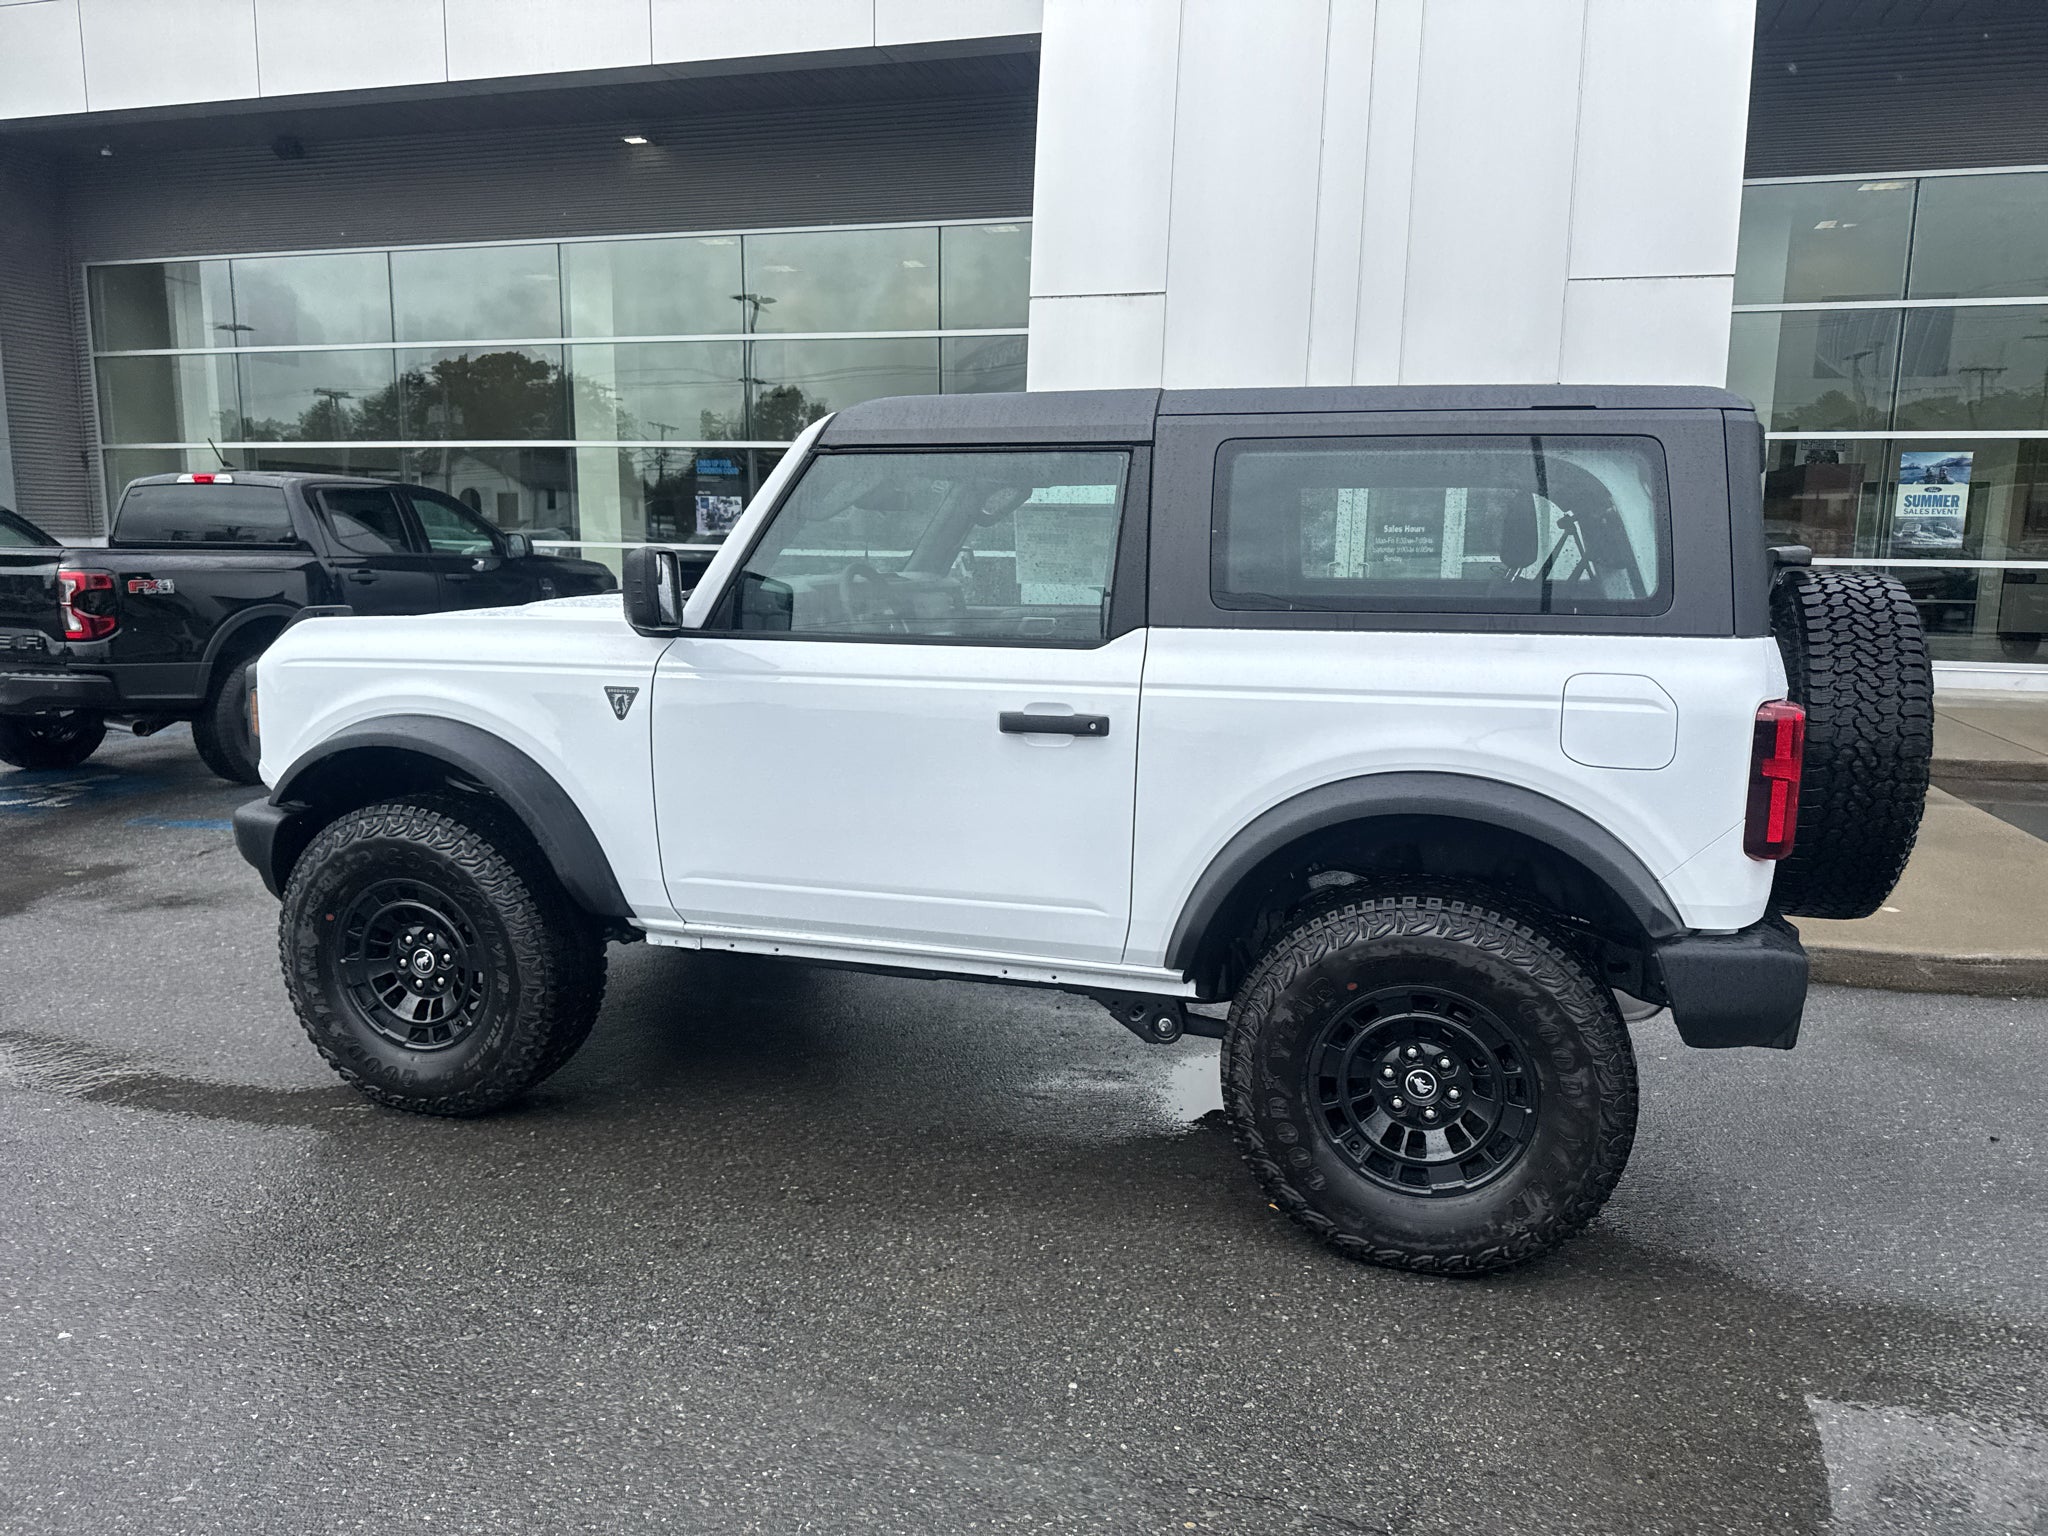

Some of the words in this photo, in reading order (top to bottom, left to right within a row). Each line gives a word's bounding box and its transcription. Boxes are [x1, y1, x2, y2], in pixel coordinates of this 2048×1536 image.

[1904, 494, 1960, 508] SUMMER
[1383, 524, 1403, 533] Sales
[1404, 524, 1425, 533] Hours
[128, 579, 174, 594] FX4
